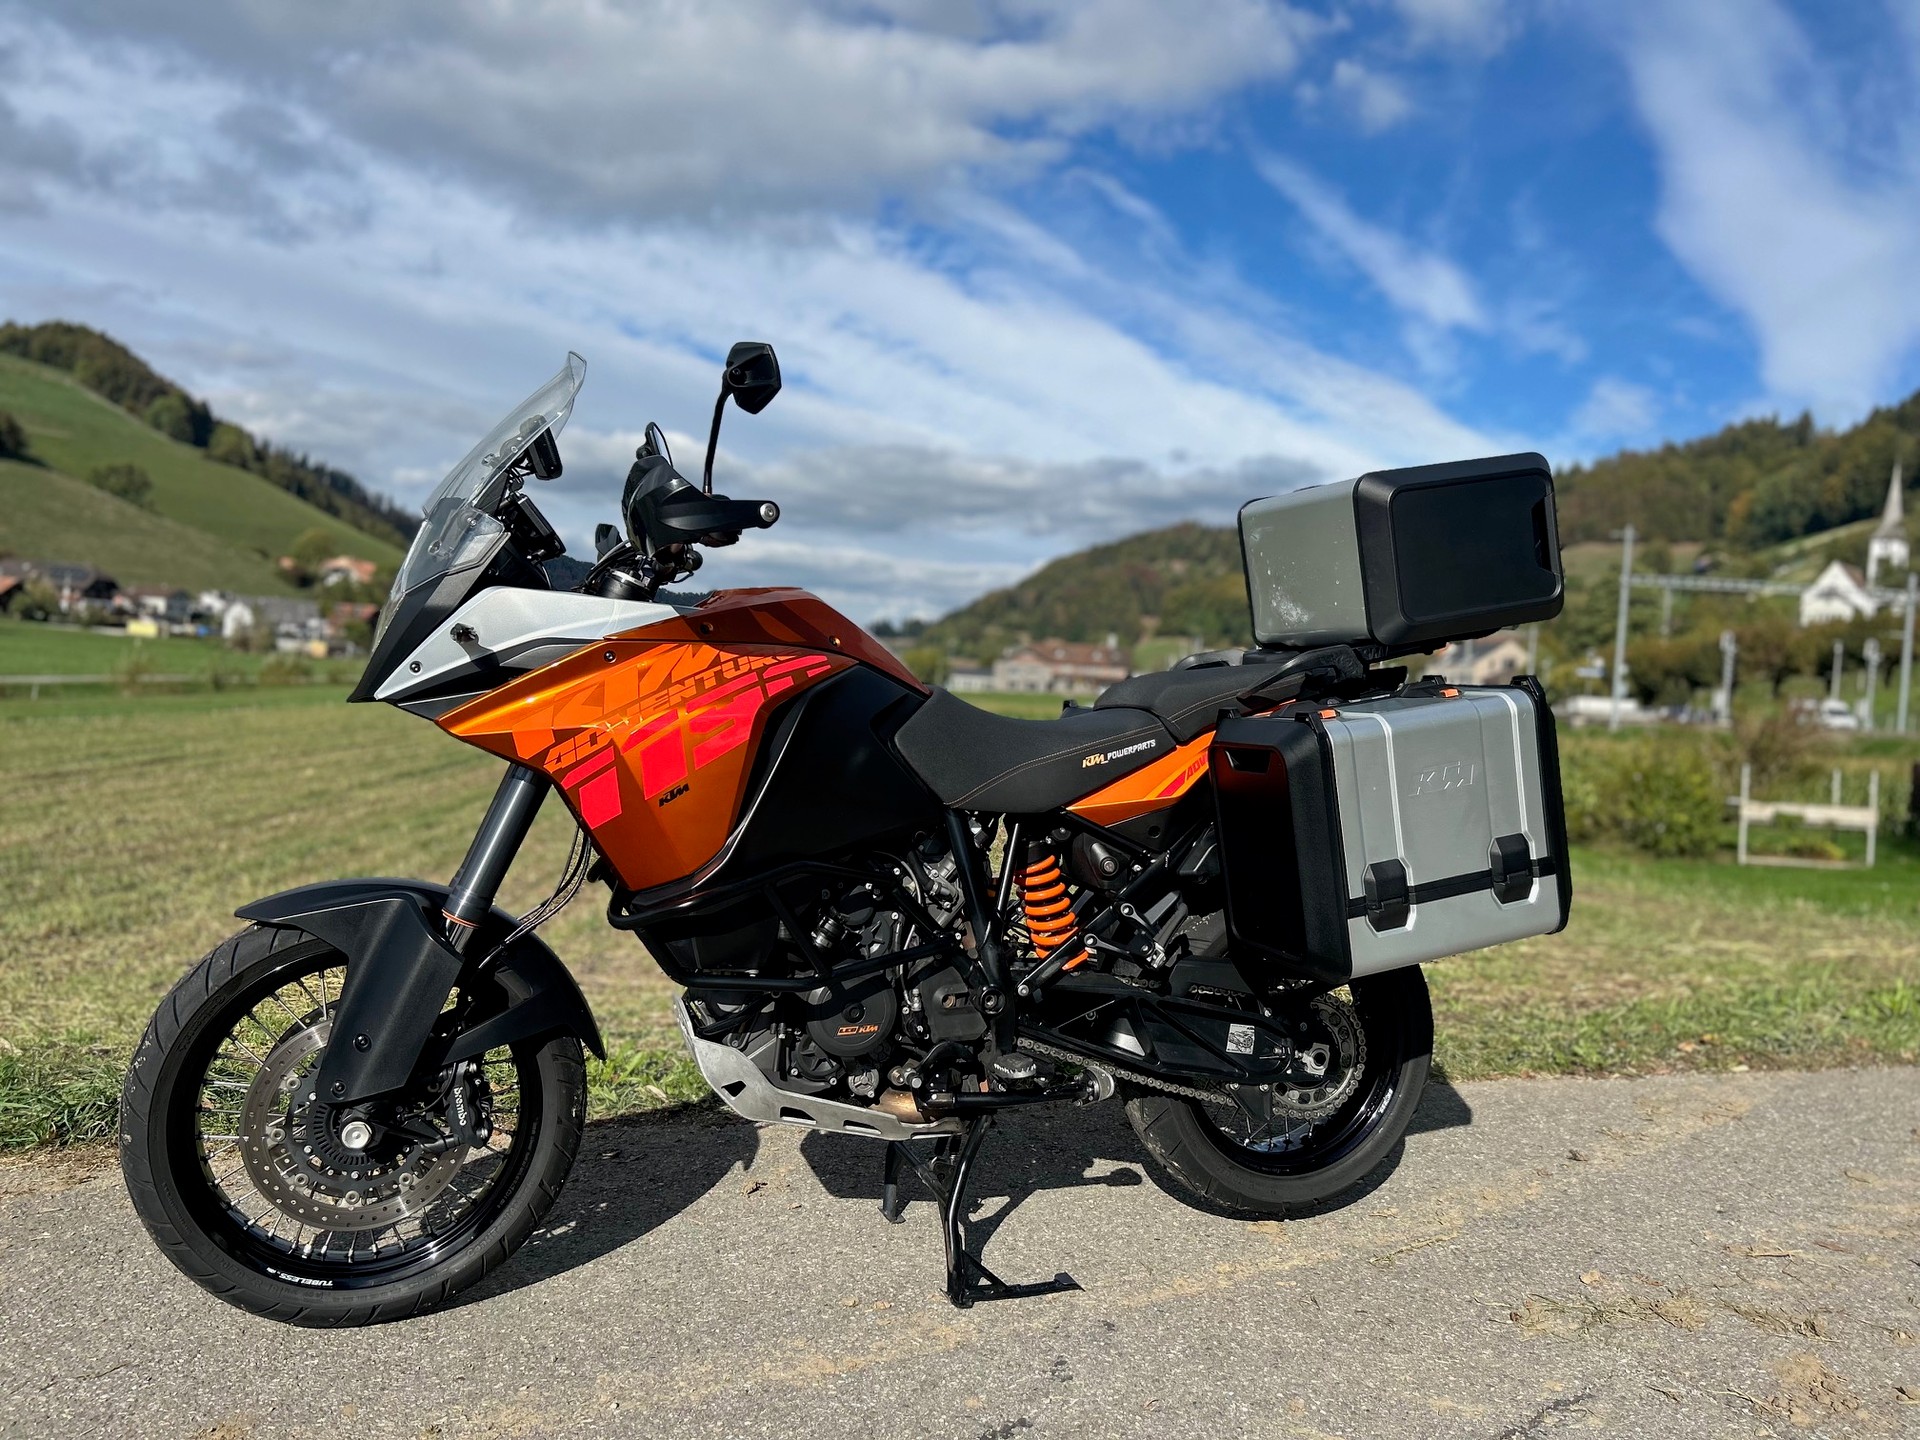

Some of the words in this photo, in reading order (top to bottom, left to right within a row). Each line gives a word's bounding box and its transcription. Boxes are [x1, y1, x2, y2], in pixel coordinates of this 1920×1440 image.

[1082, 753, 1105, 768] KTM
[1107, 739, 1156, 760] POWERPARTS
[1407, 760, 1477, 798] KTM
[658, 783, 690, 808] KTM
[453, 1086, 468, 1126] brembo
[279, 1272, 334, 1287] TUBELESS
